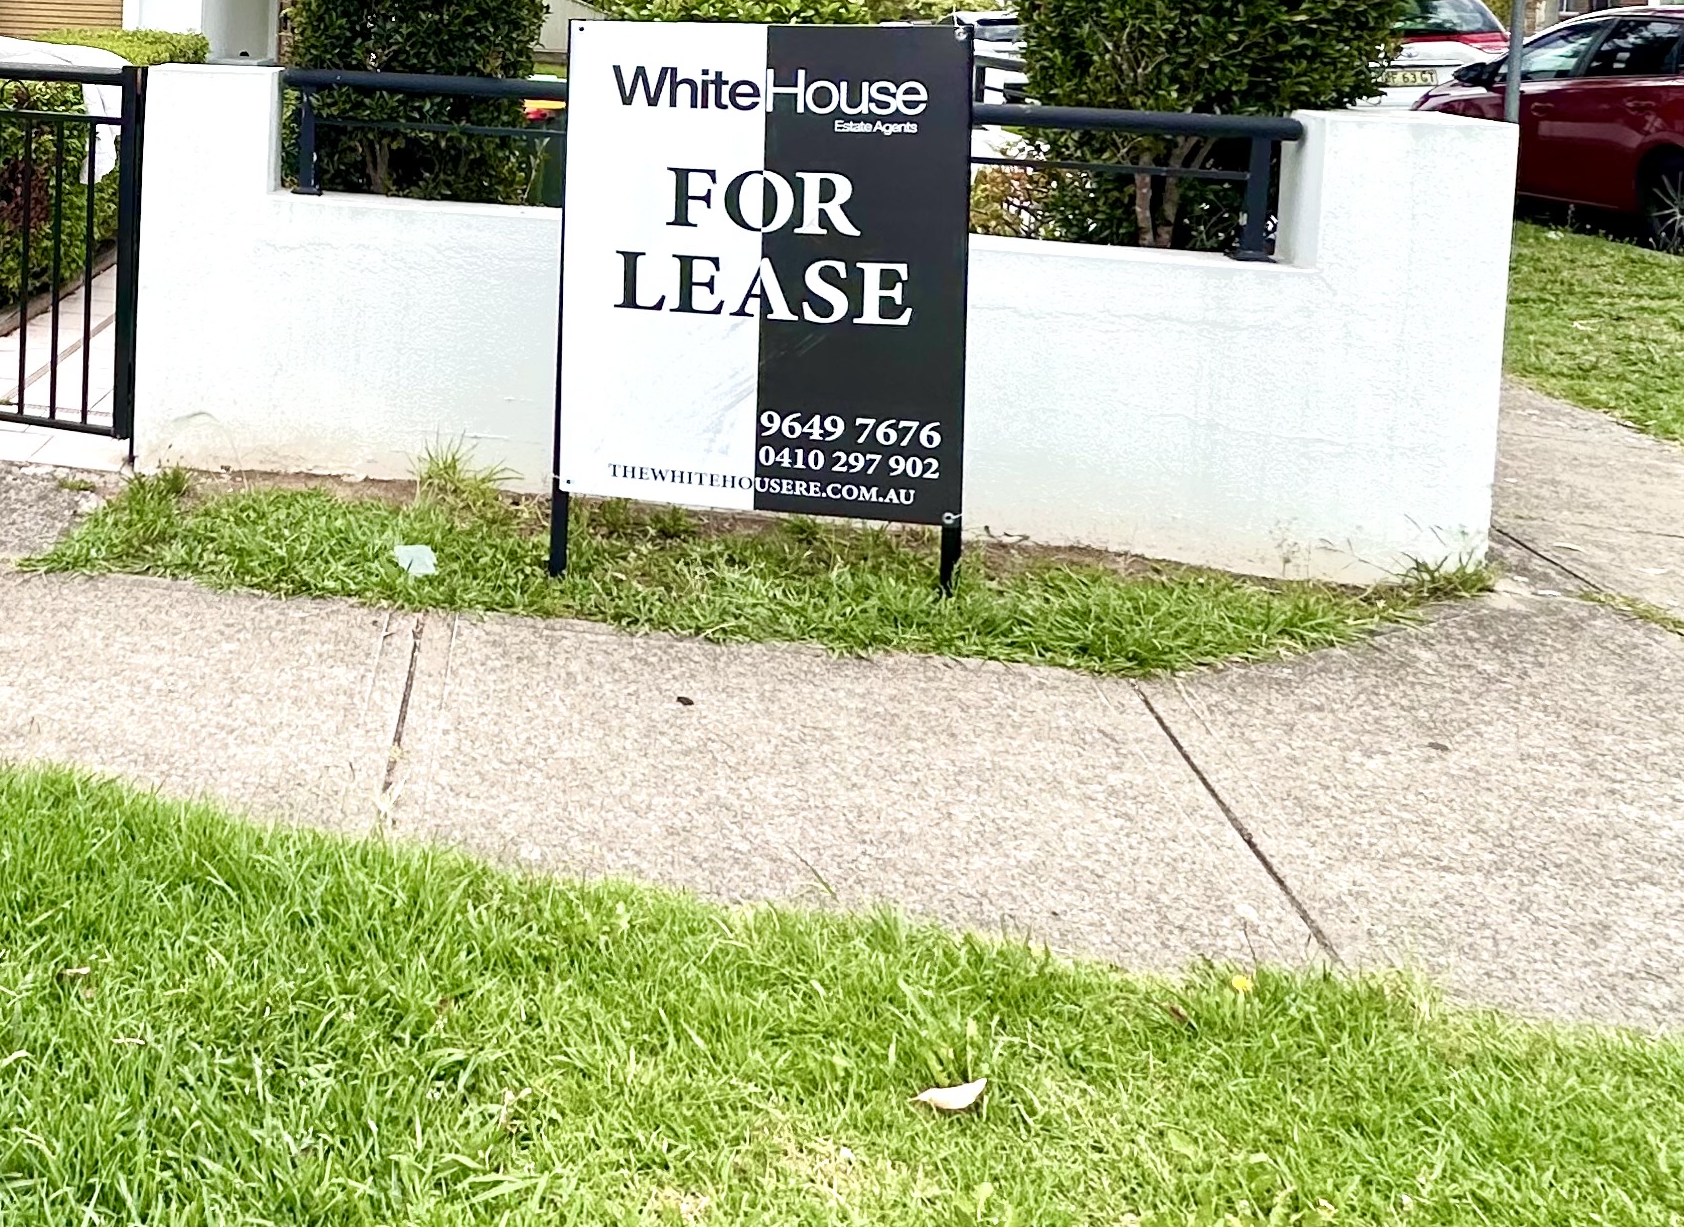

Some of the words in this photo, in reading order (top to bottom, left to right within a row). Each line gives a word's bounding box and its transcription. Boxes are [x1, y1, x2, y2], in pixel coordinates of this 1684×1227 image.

[834, 120, 873, 133] Estate
[873, 120, 918, 136] Agents
[666, 167, 862, 237] FOR
[614, 250, 914, 326] LEASE
[759, 410, 846, 442] 9649
[854, 417, 943, 449] 7676
[758, 445, 826, 471] 0410
[831, 451, 883, 475] 297
[888, 455, 940, 479] 902
[608, 462, 916, 505] THEWHITEHOUSERE.COM.AU
